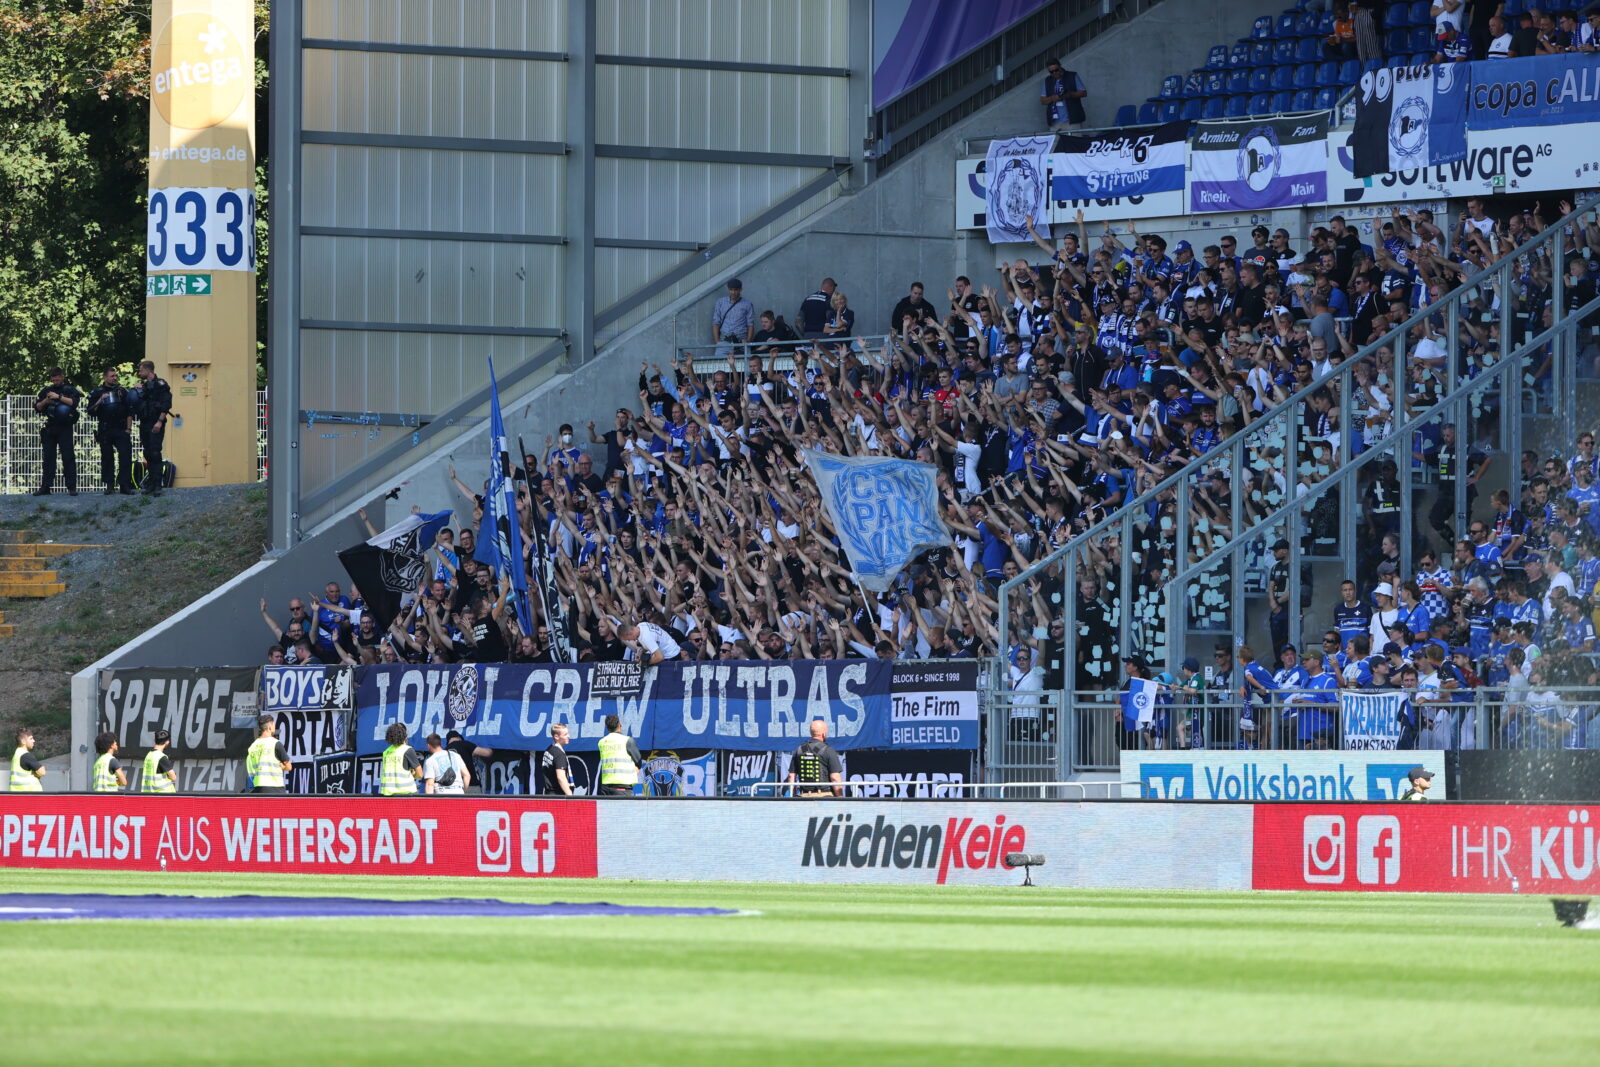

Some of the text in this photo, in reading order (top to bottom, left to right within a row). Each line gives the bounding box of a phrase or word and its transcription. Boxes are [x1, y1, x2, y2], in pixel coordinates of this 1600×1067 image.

[155, 57, 242, 94] entega
[1396, 63, 1431, 84] PLUS
[1474, 79, 1537, 117] copa
[1199, 126, 1318, 144] Arminia Fans
[1535, 143, 1553, 157] AG
[162, 145, 247, 164] entega.de
[1290, 182, 1316, 197] Main
[266, 670, 324, 709] BOYS
[893, 673, 960, 684] BLOCK 6 SINCE 1998
[104, 678, 231, 750] SPENGE
[374, 668, 501, 741] LOKL
[682, 664, 866, 738] ULTRAS
[893, 697, 960, 717] The Firm
[274, 711, 336, 757] ORTA
[893, 727, 960, 744] BIELEFELD
[1204, 763, 1354, 800] Volksbank
[0, 814, 438, 864] PEZIALIST AUS WEITERSTADT
[1452, 808, 1600, 881] IHR KÜ
